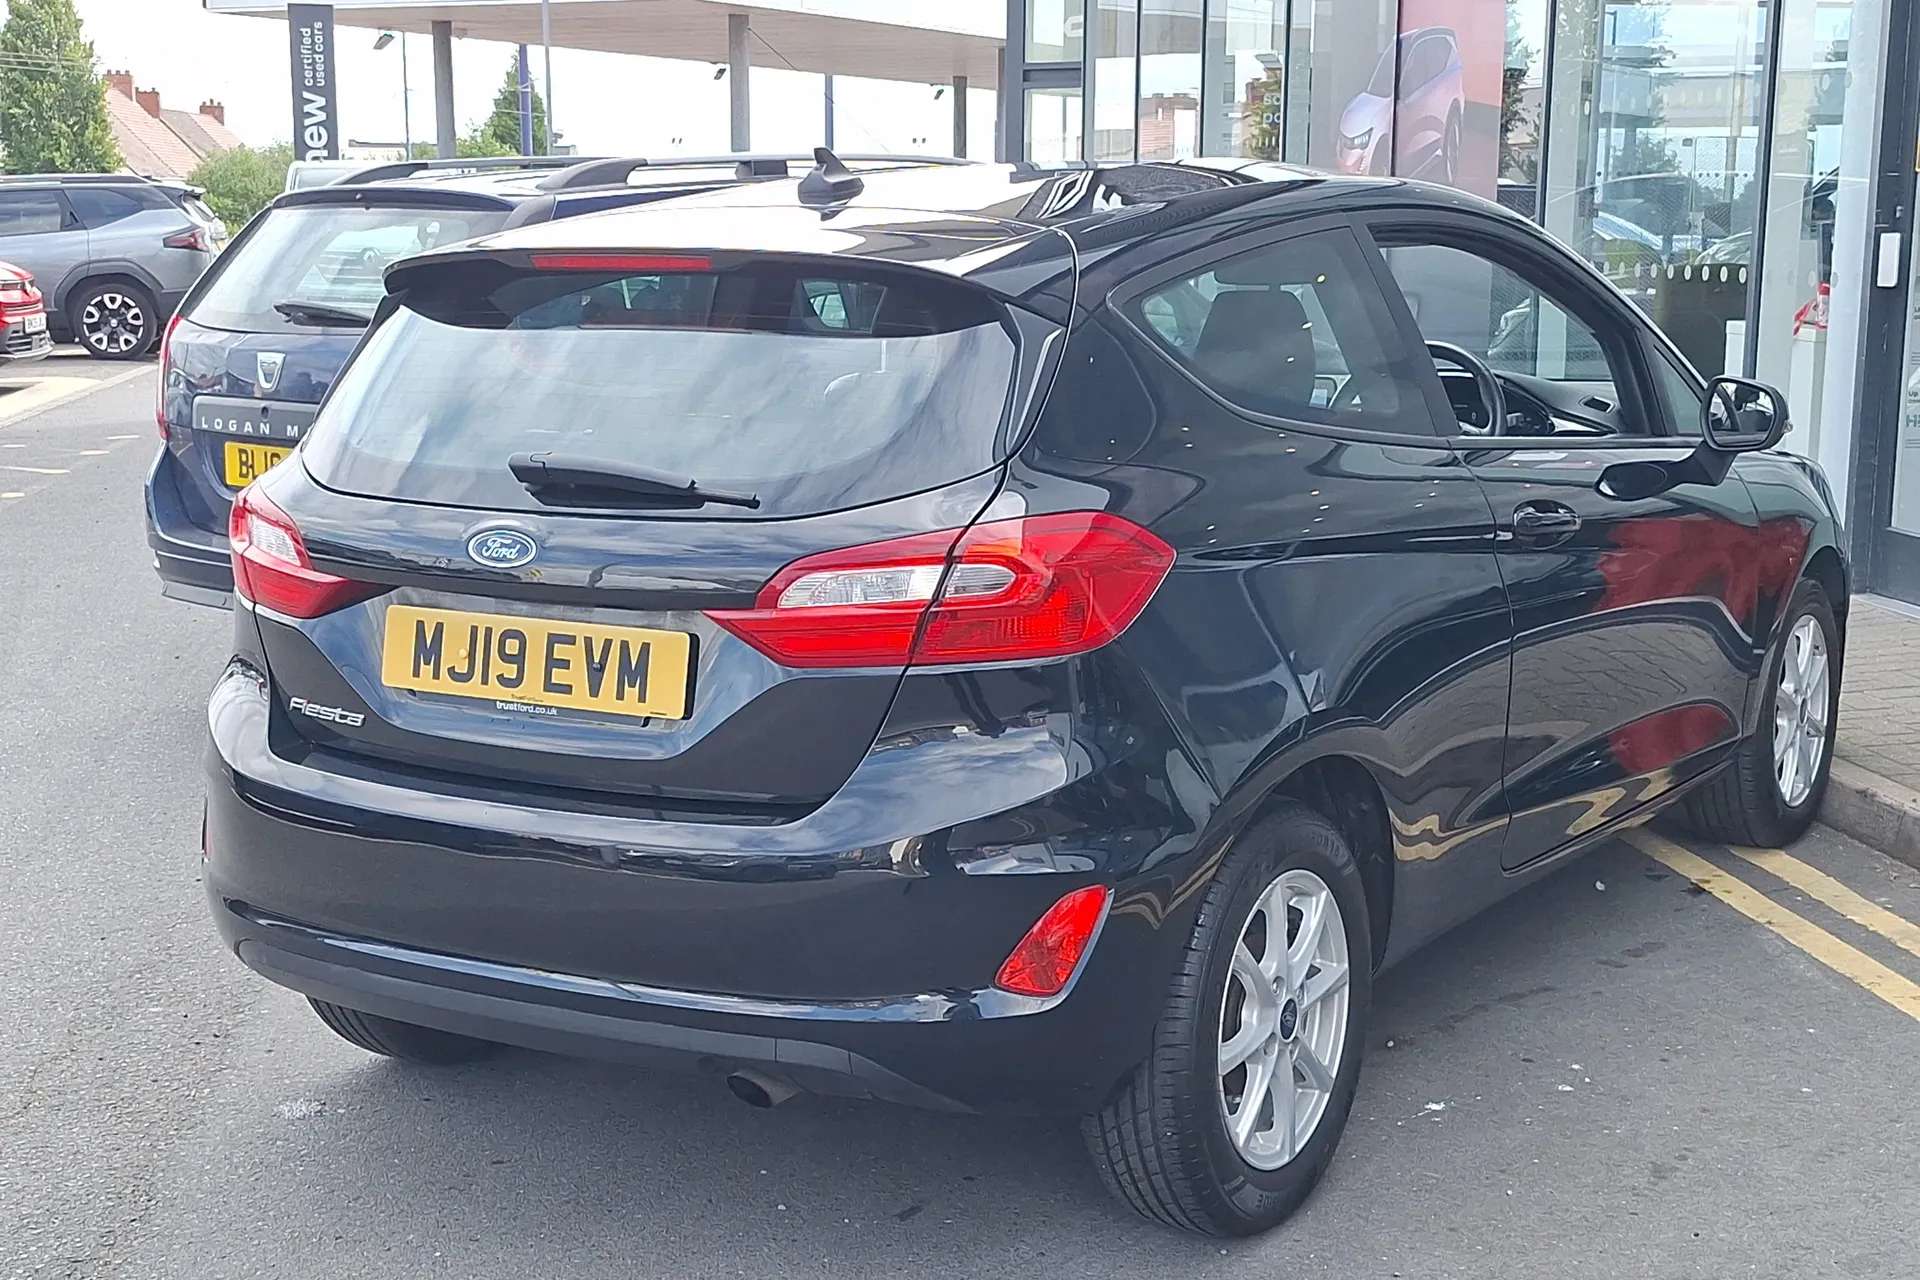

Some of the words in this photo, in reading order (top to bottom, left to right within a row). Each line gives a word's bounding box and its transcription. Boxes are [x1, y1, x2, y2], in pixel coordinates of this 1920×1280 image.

[313, 21, 324, 52] cars
[300, 27, 314, 87] certified
[313, 53, 325, 87] used
[201, 416, 270, 435] LOGAN
[481, 536, 521, 560] Ford
[412, 619, 528, 690] MJ19
[543, 631, 651, 704] EVM
[289, 697, 365, 727] Fiesta
[495, 700, 558, 716] trustford.co.uk
